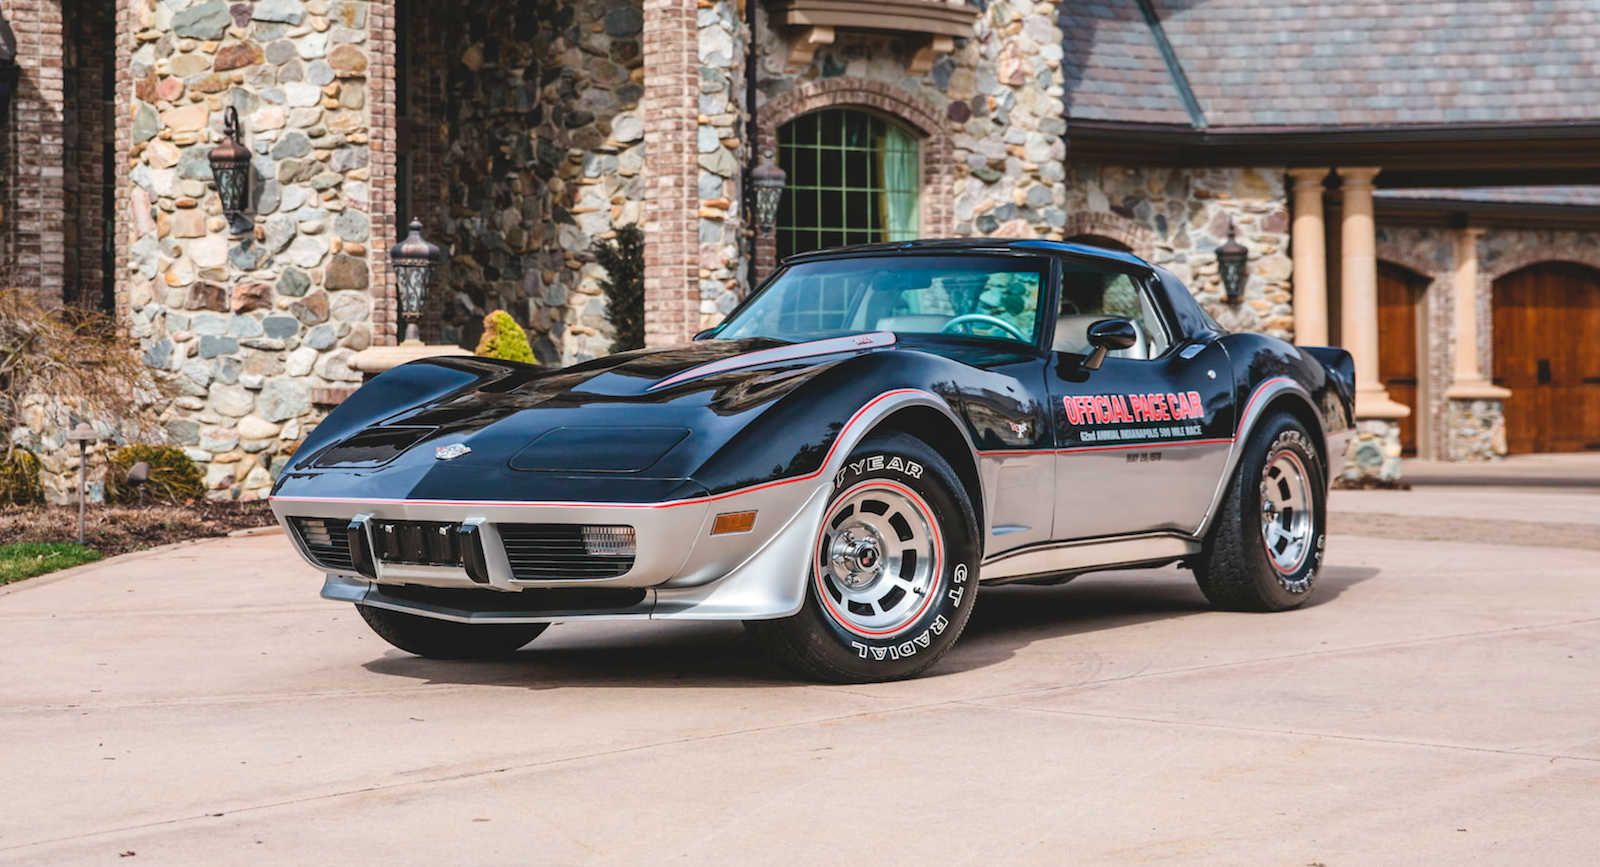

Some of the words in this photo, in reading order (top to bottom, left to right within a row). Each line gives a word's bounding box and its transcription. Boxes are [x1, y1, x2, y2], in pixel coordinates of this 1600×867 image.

[1063, 394, 1133, 425] OFFICIAL
[1131, 392, 1170, 421] PACE
[1168, 391, 1204, 419] CAR
[1186, 425, 1202, 435] RACE
[948, 564, 968, 608] GT
[852, 615, 949, 660] RADIAL
